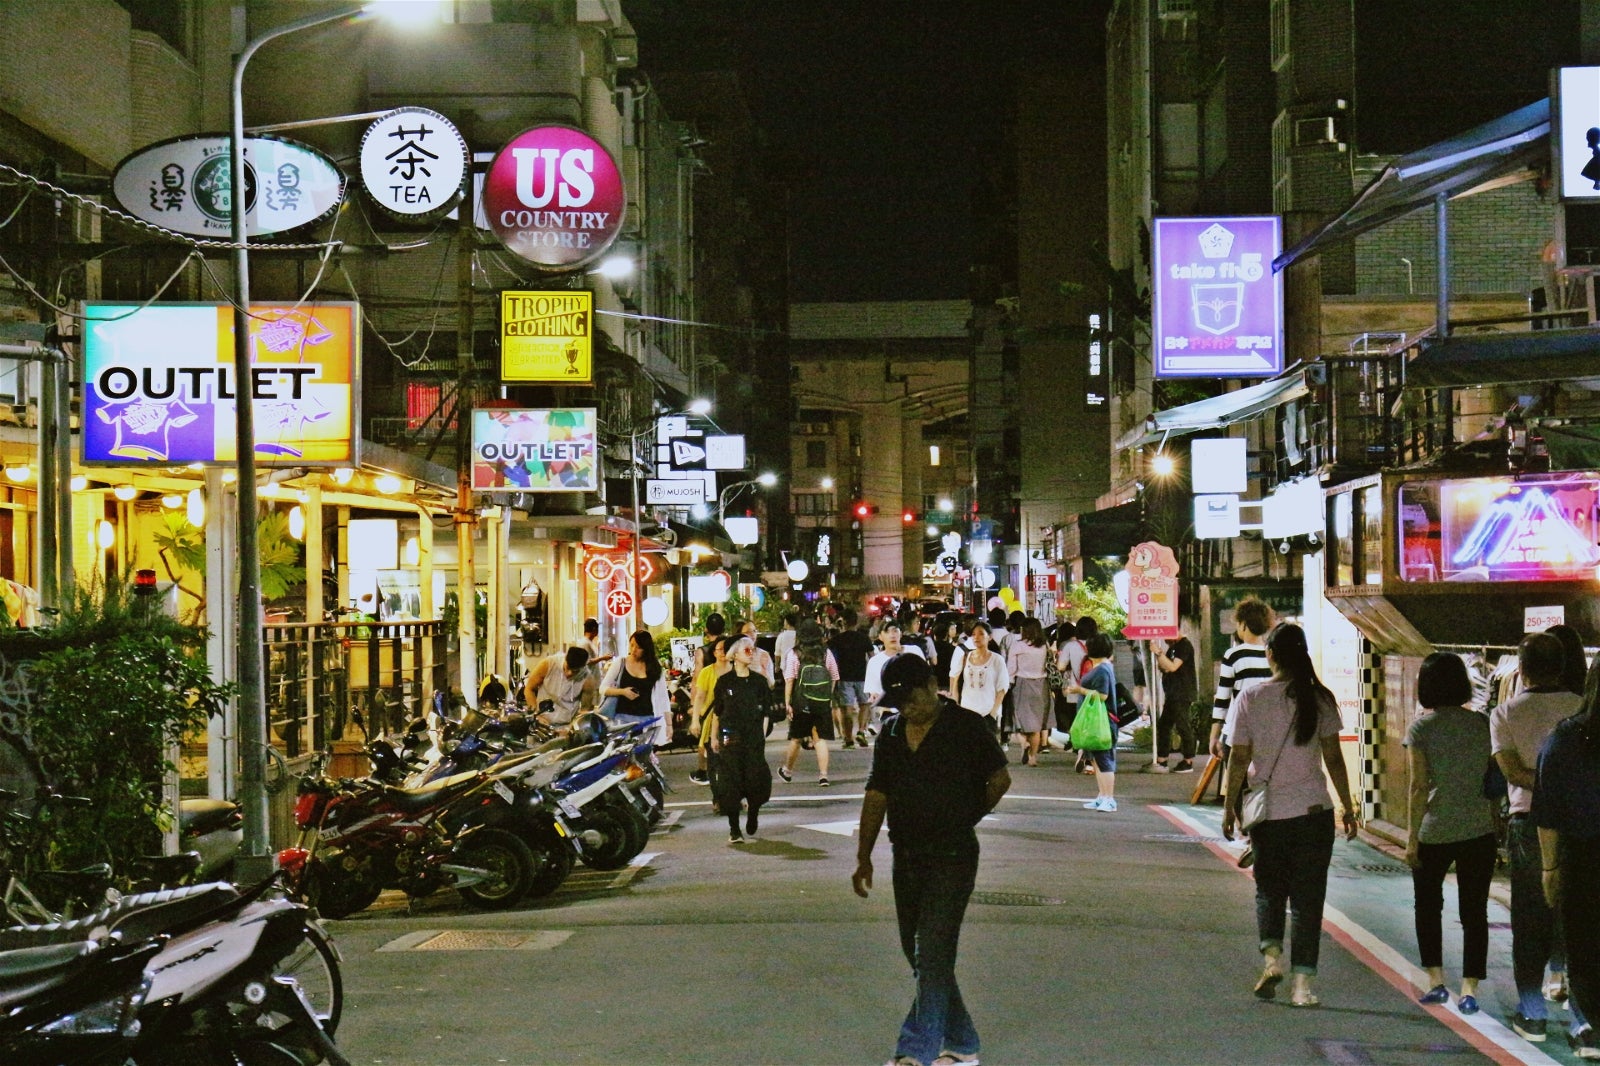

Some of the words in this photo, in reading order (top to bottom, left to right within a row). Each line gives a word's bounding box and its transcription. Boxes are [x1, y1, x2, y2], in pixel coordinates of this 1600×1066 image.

[385, 123, 438, 181] 茶
[512, 147, 595, 209] US
[389, 185, 432, 204] TEA
[500, 209, 609, 229] COUNTRY
[515, 229, 591, 249] STORE
[1169, 262, 1216, 280] take
[507, 297, 583, 320] TROPHY
[506, 312, 585, 336] CLOTHING
[99, 366, 316, 400] OUTLET
[480, 443, 586, 460] OUTLET
[667, 488, 700, 496] MUJOSH
[1526, 616, 1562, 627] 250-390
